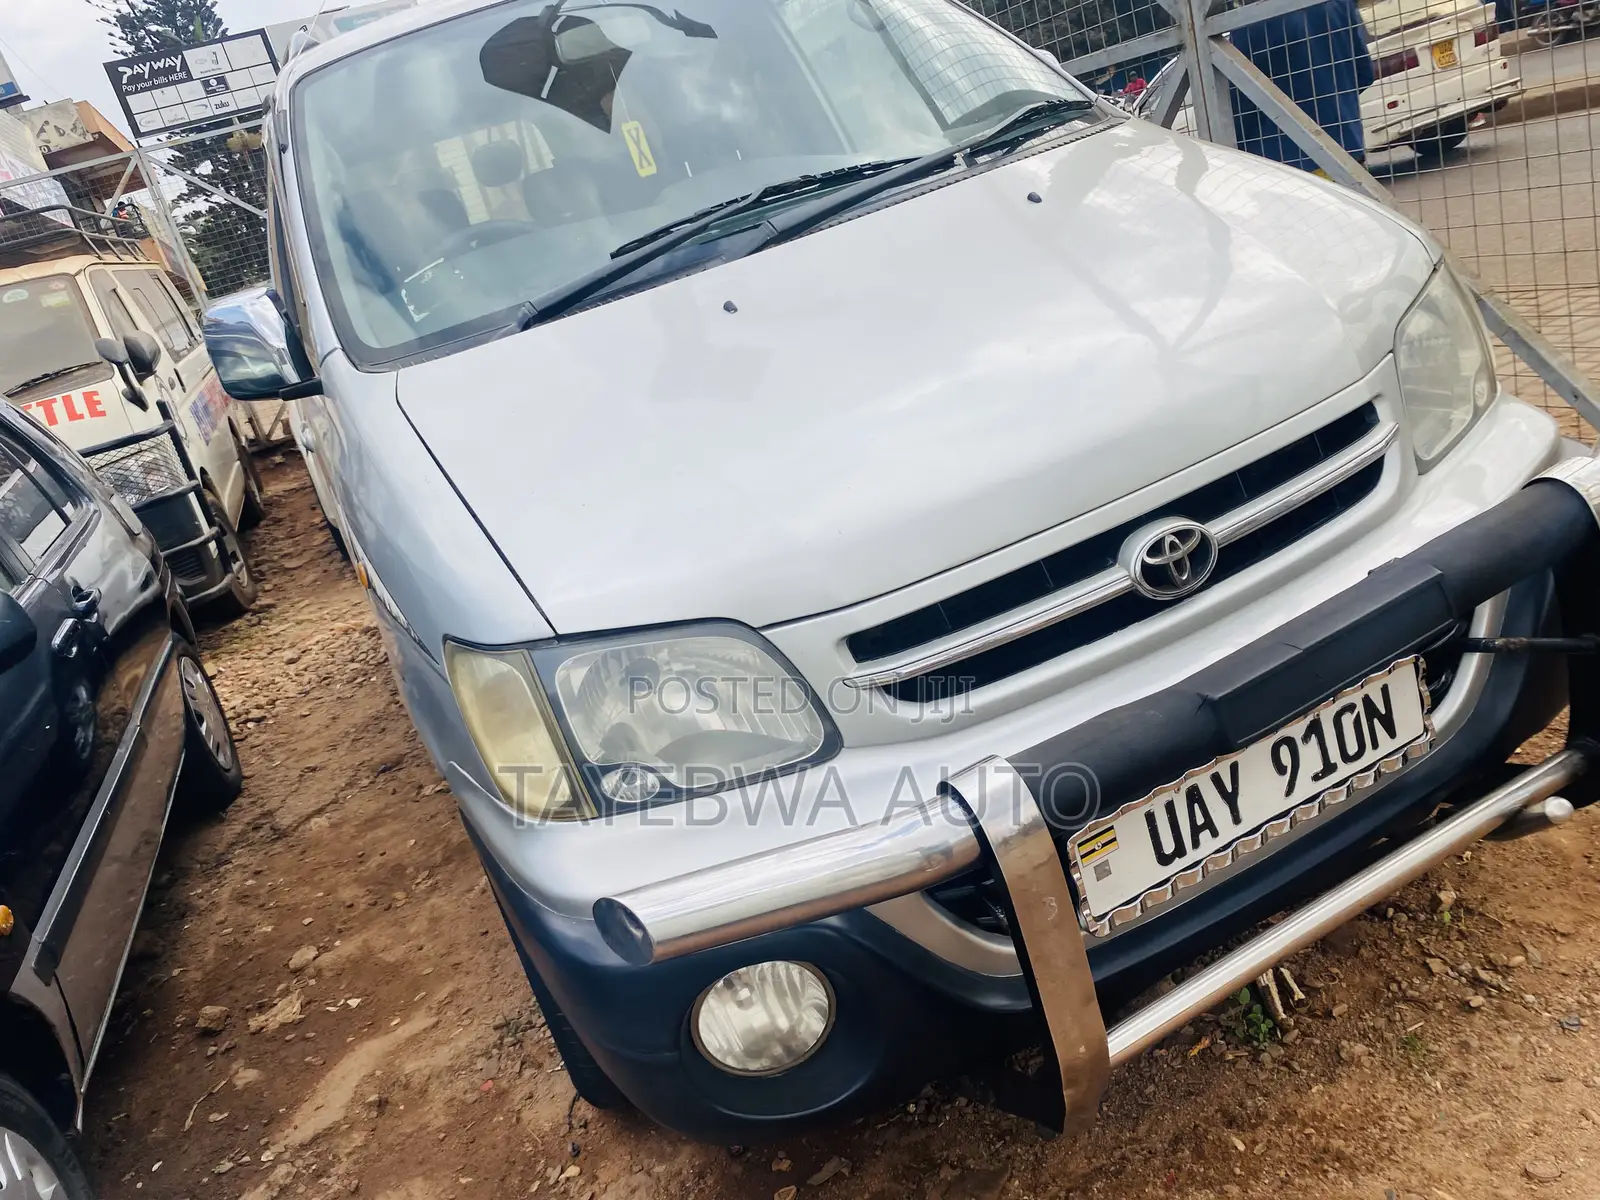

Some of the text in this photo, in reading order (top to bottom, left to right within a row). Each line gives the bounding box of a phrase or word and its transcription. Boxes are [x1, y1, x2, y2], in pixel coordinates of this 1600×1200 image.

[117, 54, 182, 84] PAYWAY
[122, 71, 188, 93] Pay your bills HERE
[214, 100, 230, 110] zuku
[1144, 683, 1397, 867] UAY 910N
